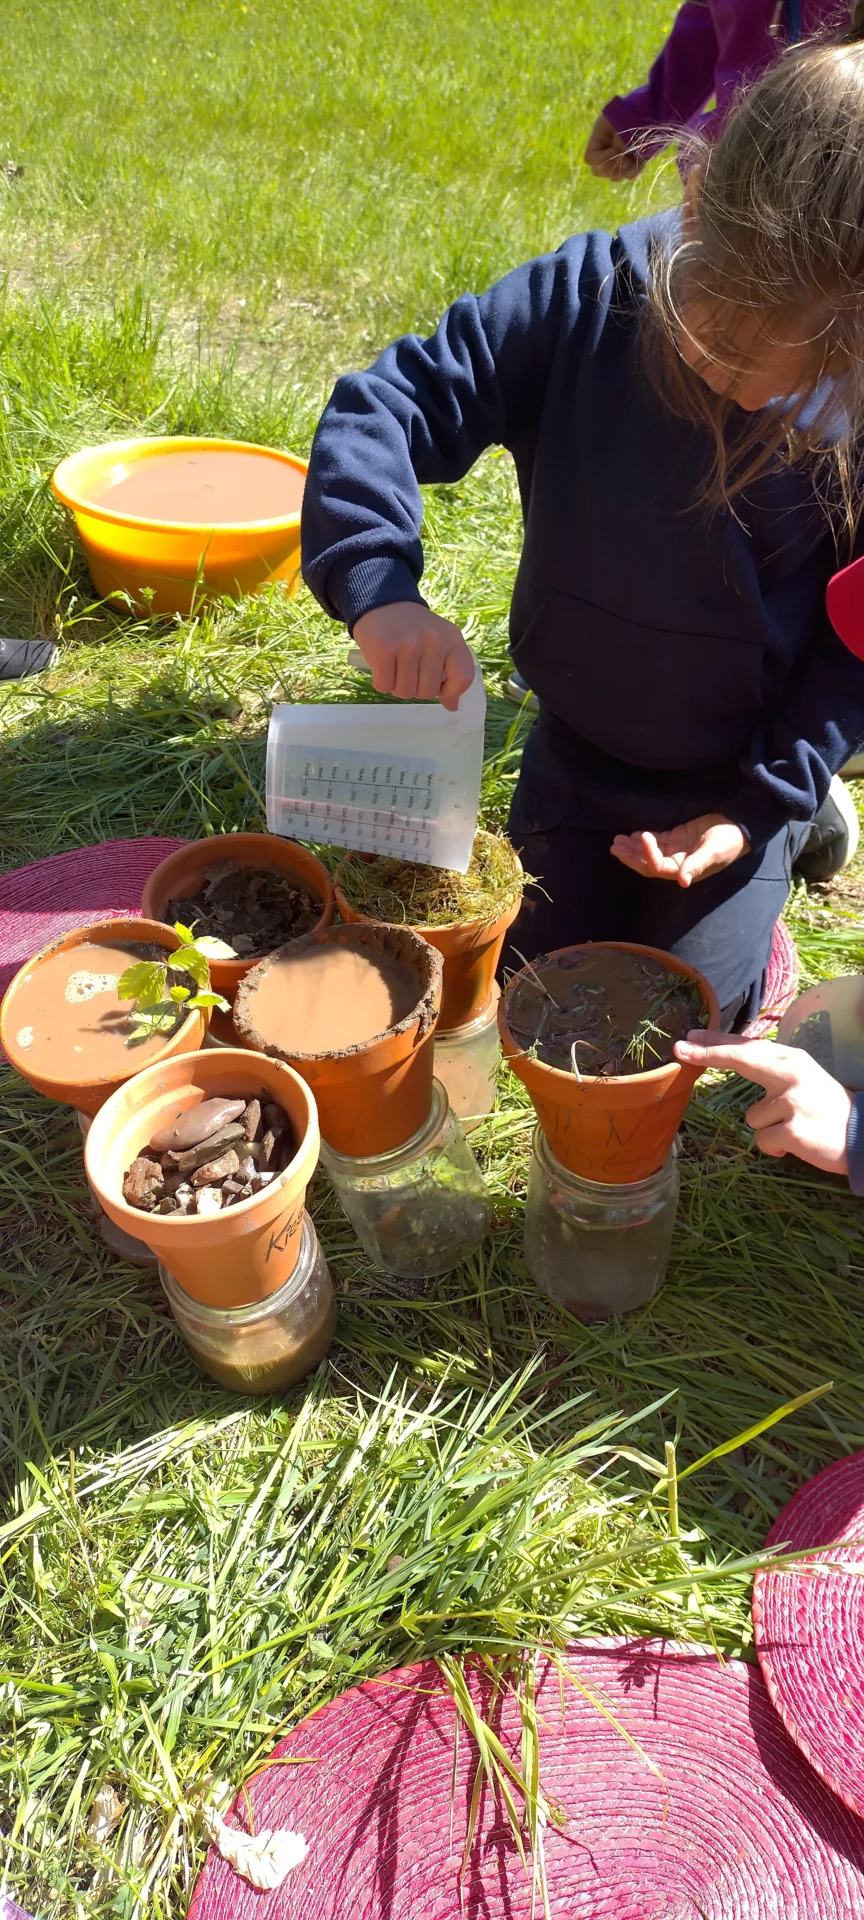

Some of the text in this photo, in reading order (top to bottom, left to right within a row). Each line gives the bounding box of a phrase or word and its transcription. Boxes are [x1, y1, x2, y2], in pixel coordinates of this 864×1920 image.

[325, 787, 333, 800] 200g
[390, 793, 398, 807] 500g
[406, 795, 414, 809] 600g
[423, 797, 432, 811] 700g
